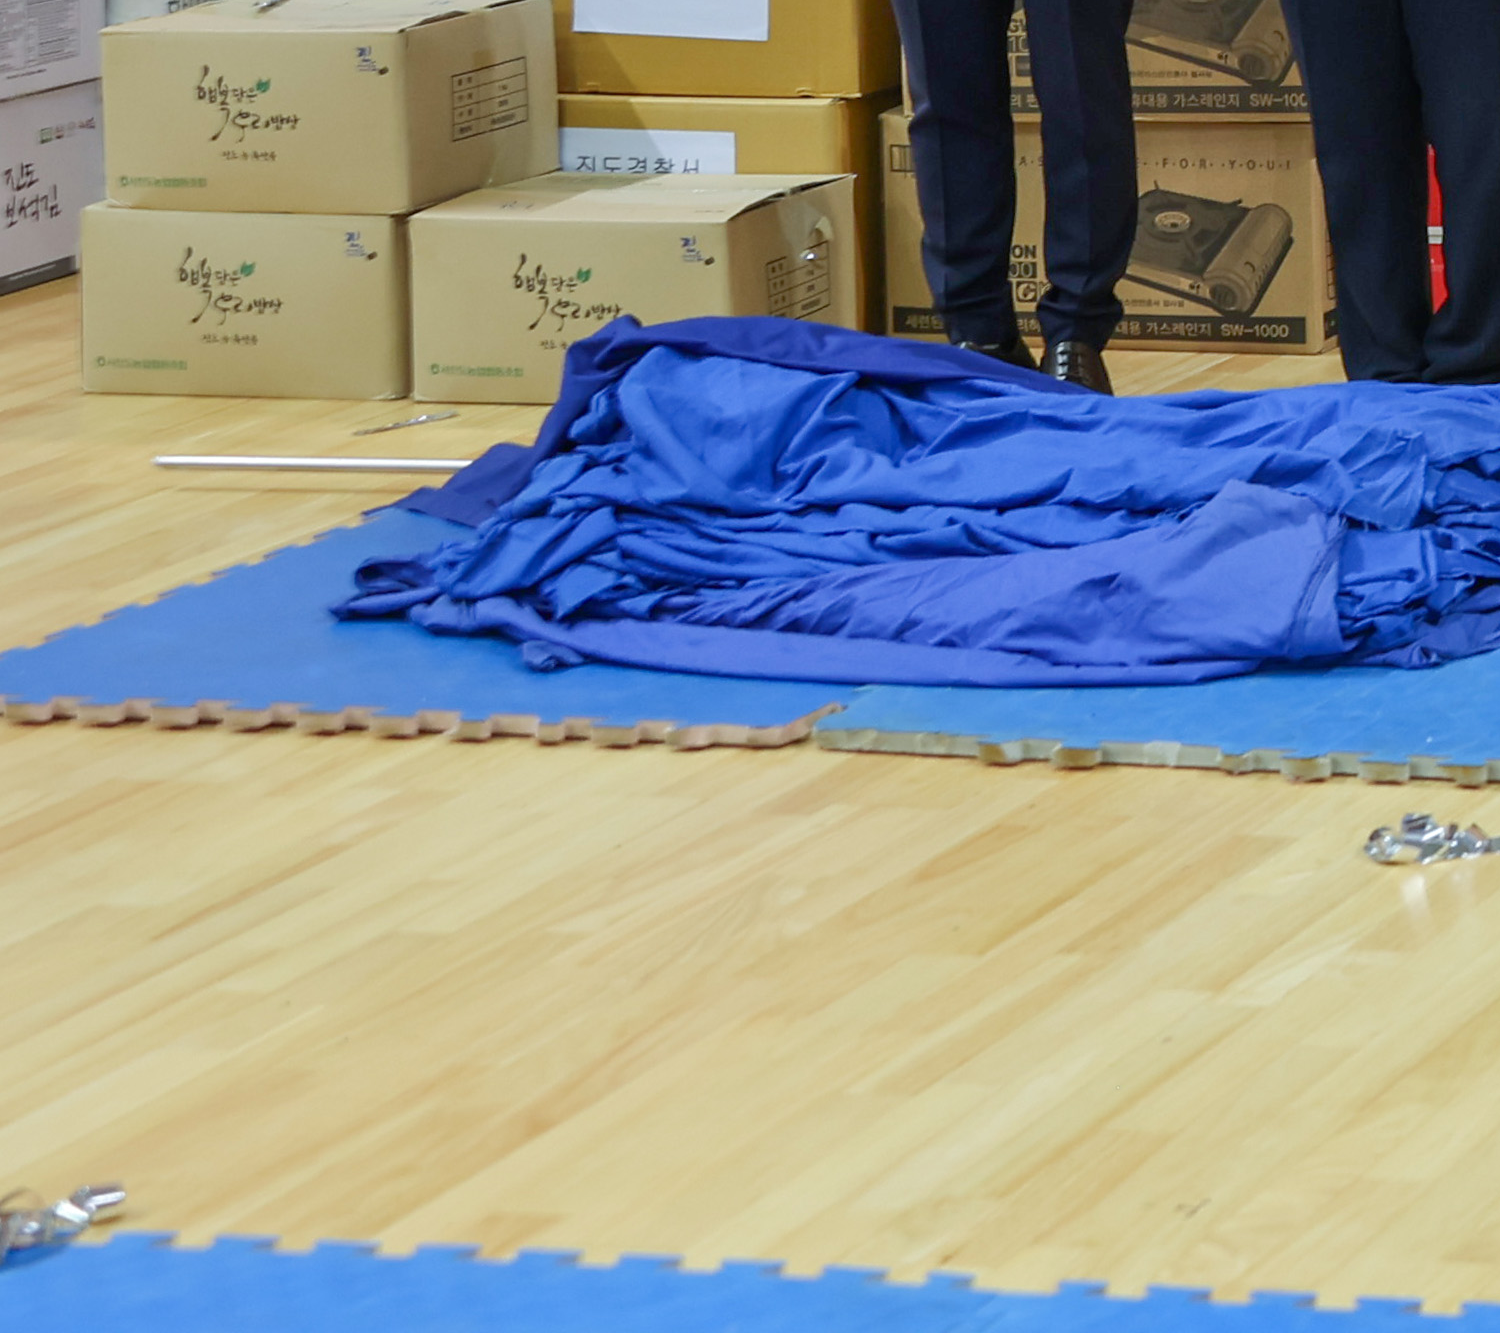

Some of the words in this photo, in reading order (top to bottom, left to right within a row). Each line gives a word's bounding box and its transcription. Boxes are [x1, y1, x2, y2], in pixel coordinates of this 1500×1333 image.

[1173, 92, 1240, 108] 가스레인지
[3, 162, 40, 189] 진도
[3, 184, 63, 230] 보석김
[1145, 321, 1212, 336] 가스레인지
[1220, 322, 1290, 338] SW-1000
